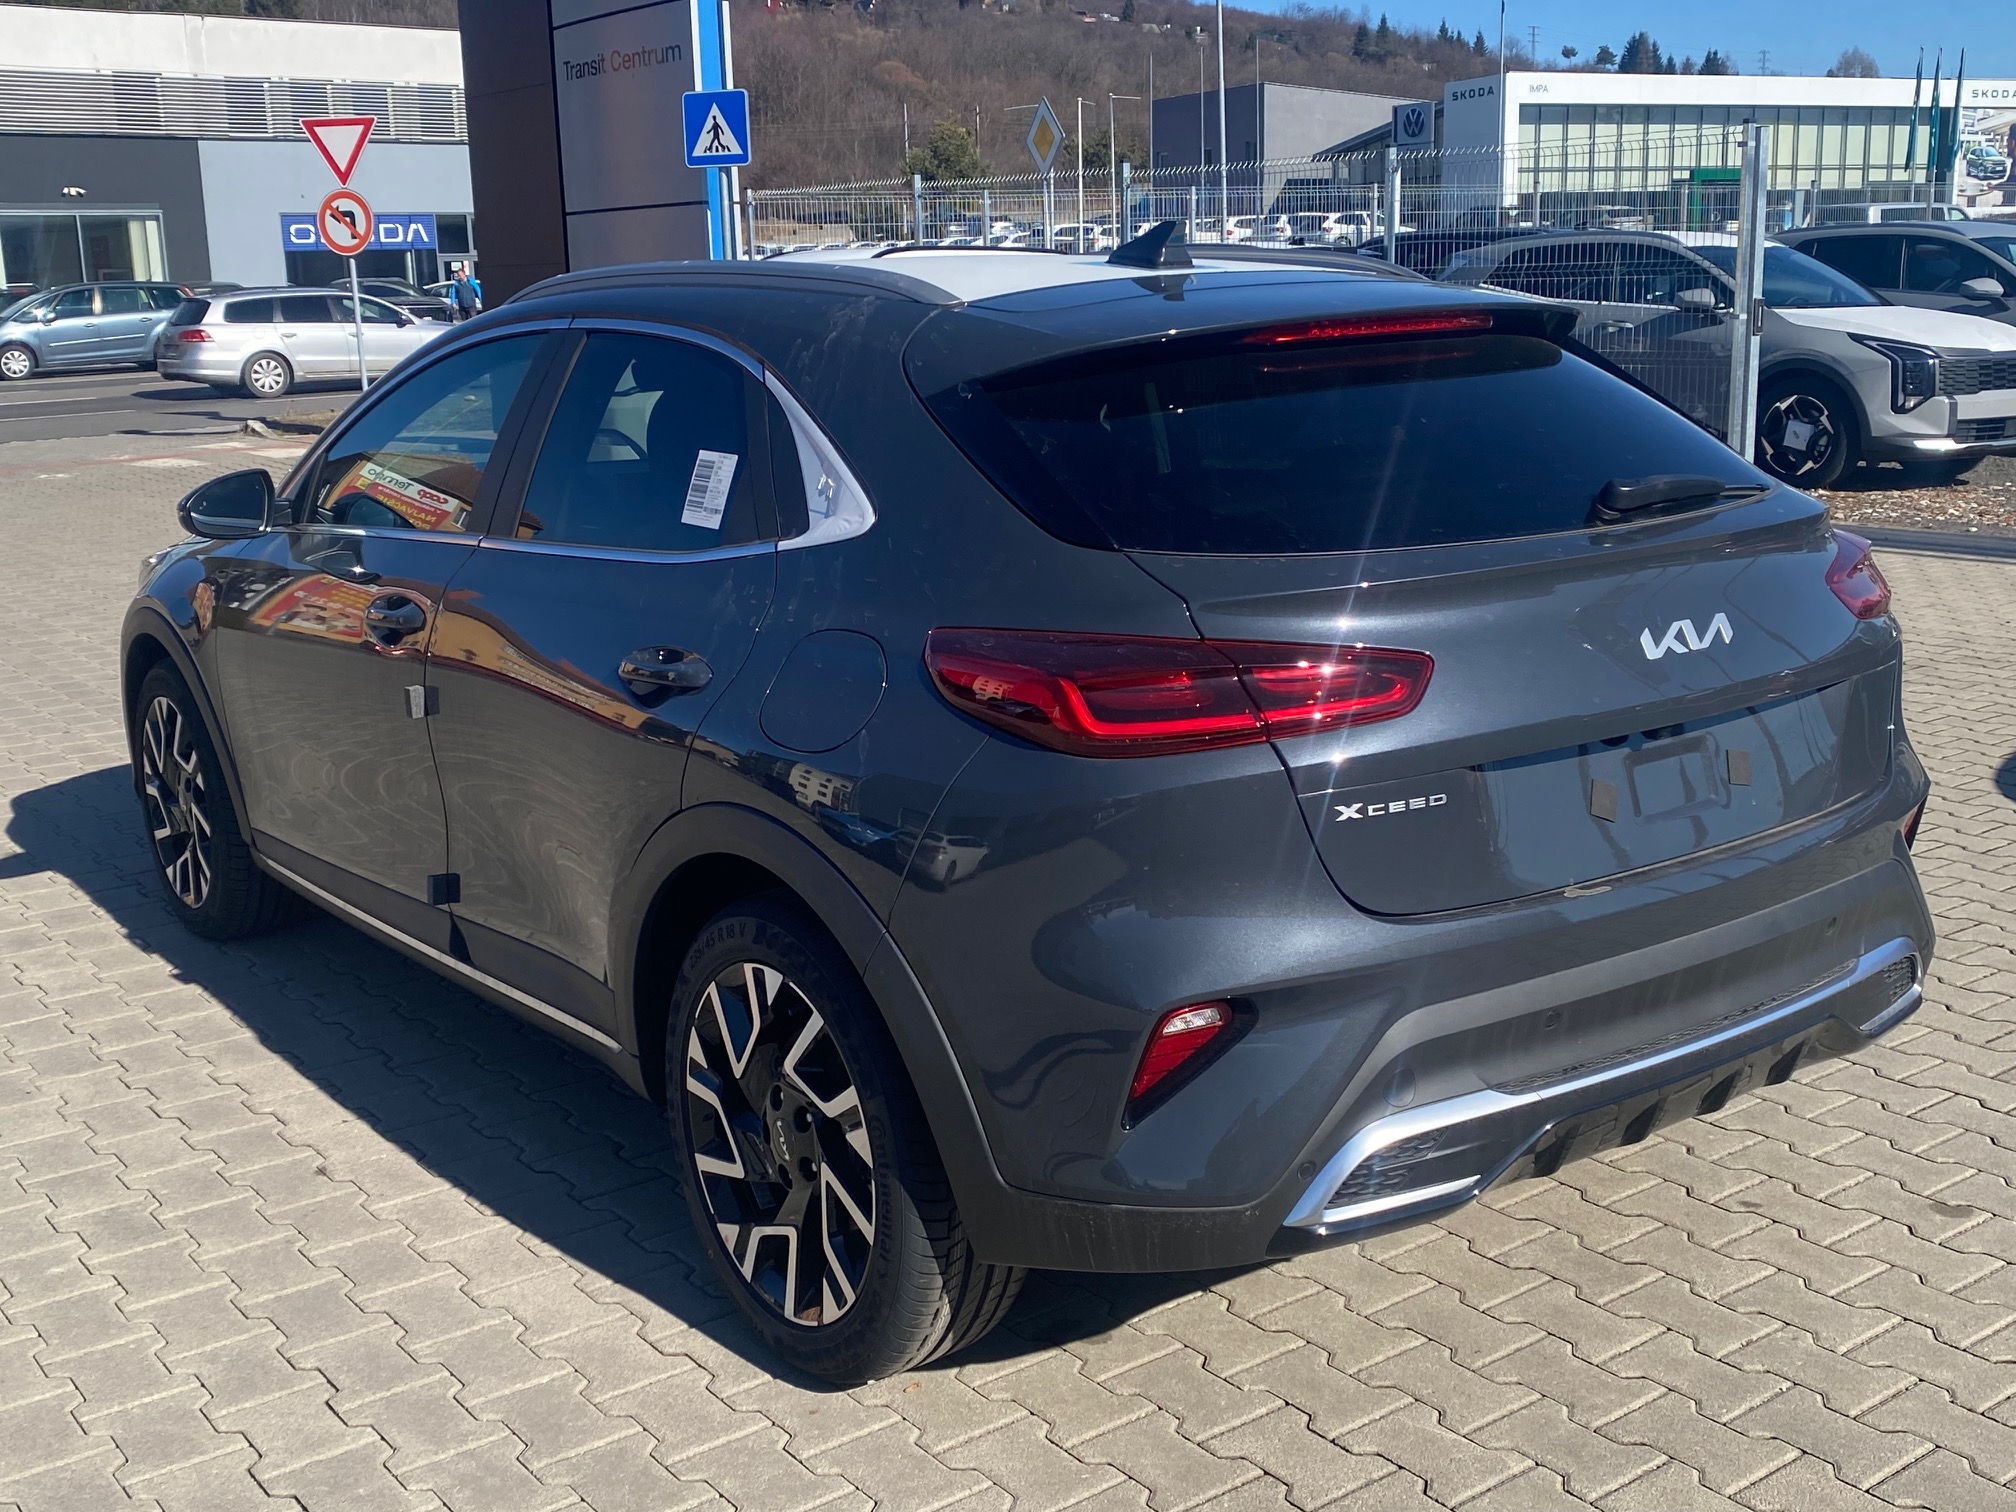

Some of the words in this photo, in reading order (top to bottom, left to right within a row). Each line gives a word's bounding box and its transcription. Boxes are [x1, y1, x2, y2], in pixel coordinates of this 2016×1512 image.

[563, 53, 606, 81] Transit
[610, 44, 682, 72] Centrum
[1452, 85, 1494, 101] SKODA
[1529, 84, 1549, 93] IMPA
[289, 224, 429, 244] ODA
[1640, 612, 1734, 660] KIA
[1333, 793, 1447, 822] XCEED
